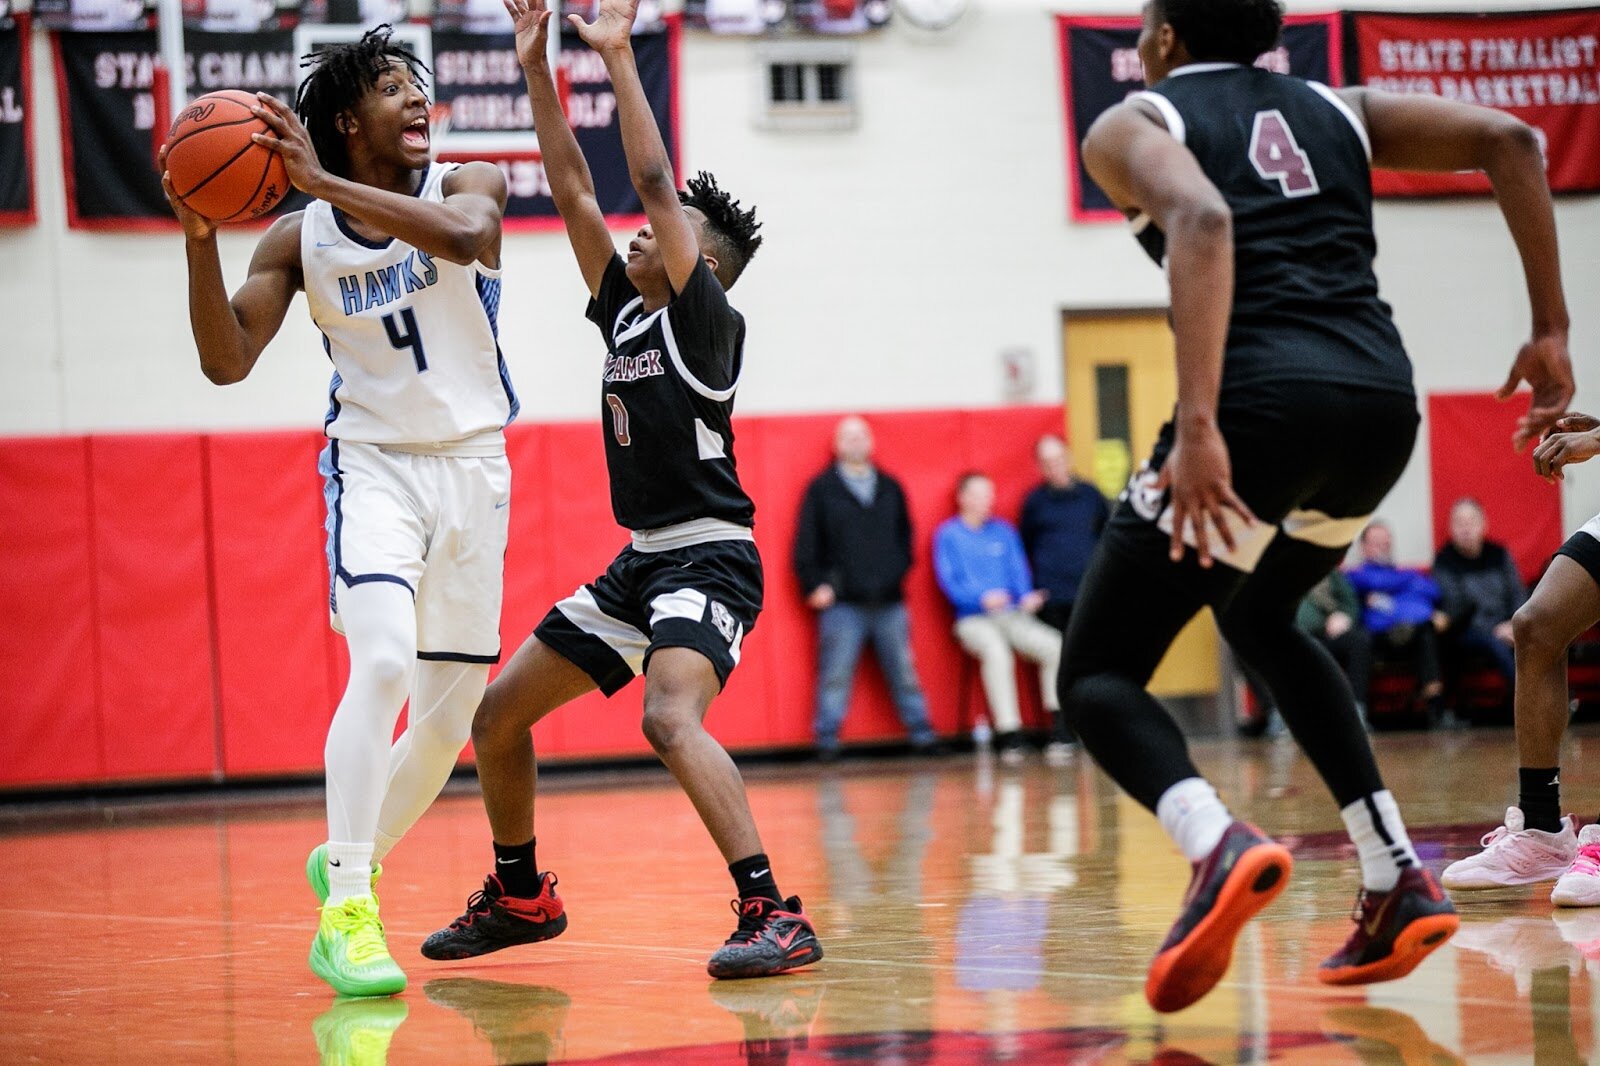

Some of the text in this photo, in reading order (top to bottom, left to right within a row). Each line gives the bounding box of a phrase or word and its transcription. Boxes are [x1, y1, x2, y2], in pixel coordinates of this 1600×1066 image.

[1378, 35, 1598, 72] STATE FINALIST
[1440, 74, 1600, 107] BASKETBAL
[1248, 108, 1320, 199] 4
[338, 249, 439, 316] HAWKS
[381, 305, 430, 375] 4
[606, 393, 631, 446] 0
